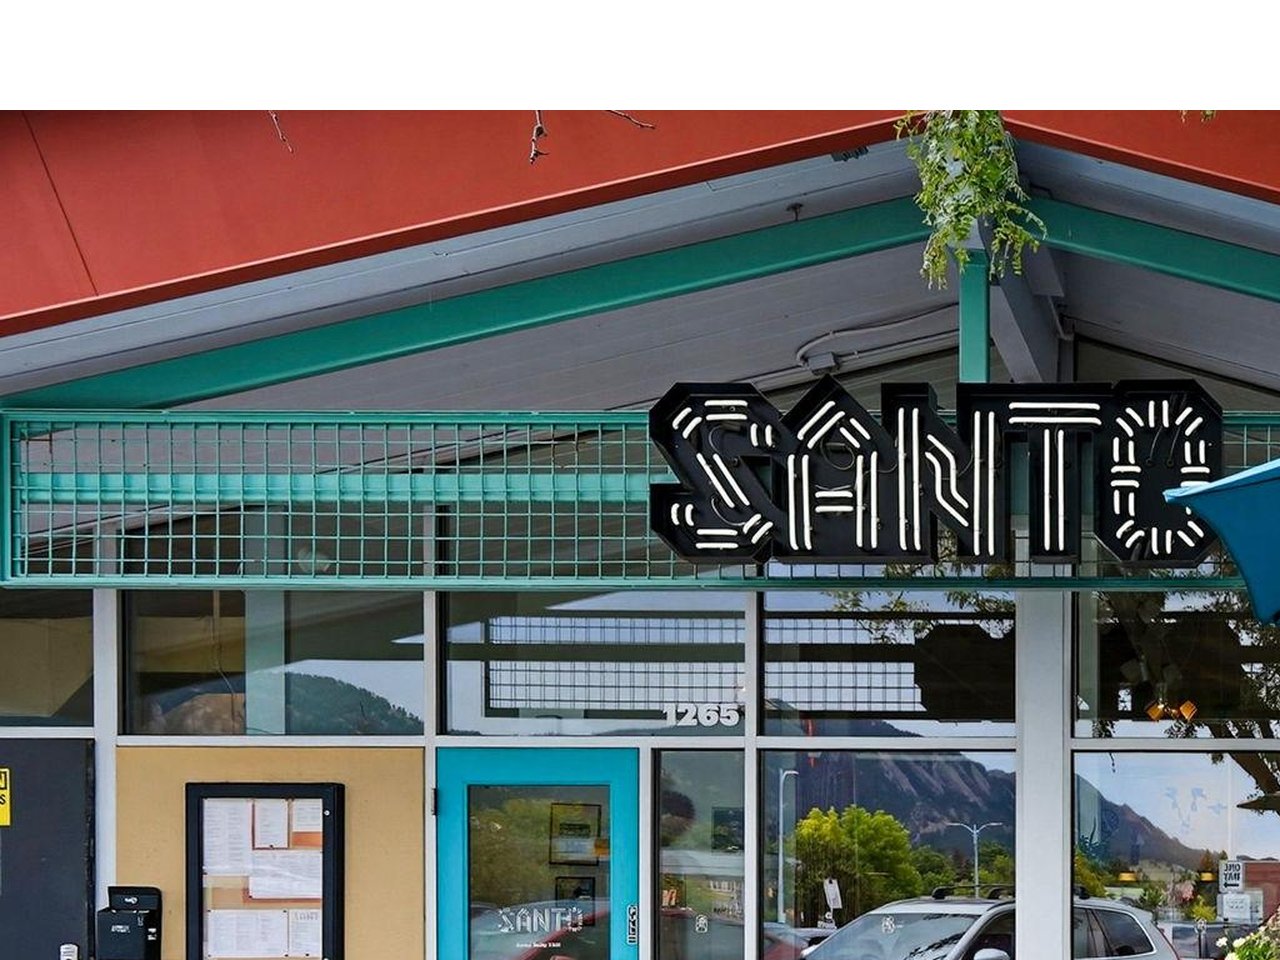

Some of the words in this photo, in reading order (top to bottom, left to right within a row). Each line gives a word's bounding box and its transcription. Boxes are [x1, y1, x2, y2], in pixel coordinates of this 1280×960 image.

[655, 384, 1220, 565] SANTO
[662, 702, 740, 727] 1265
[499, 906, 583, 933] SANTO
